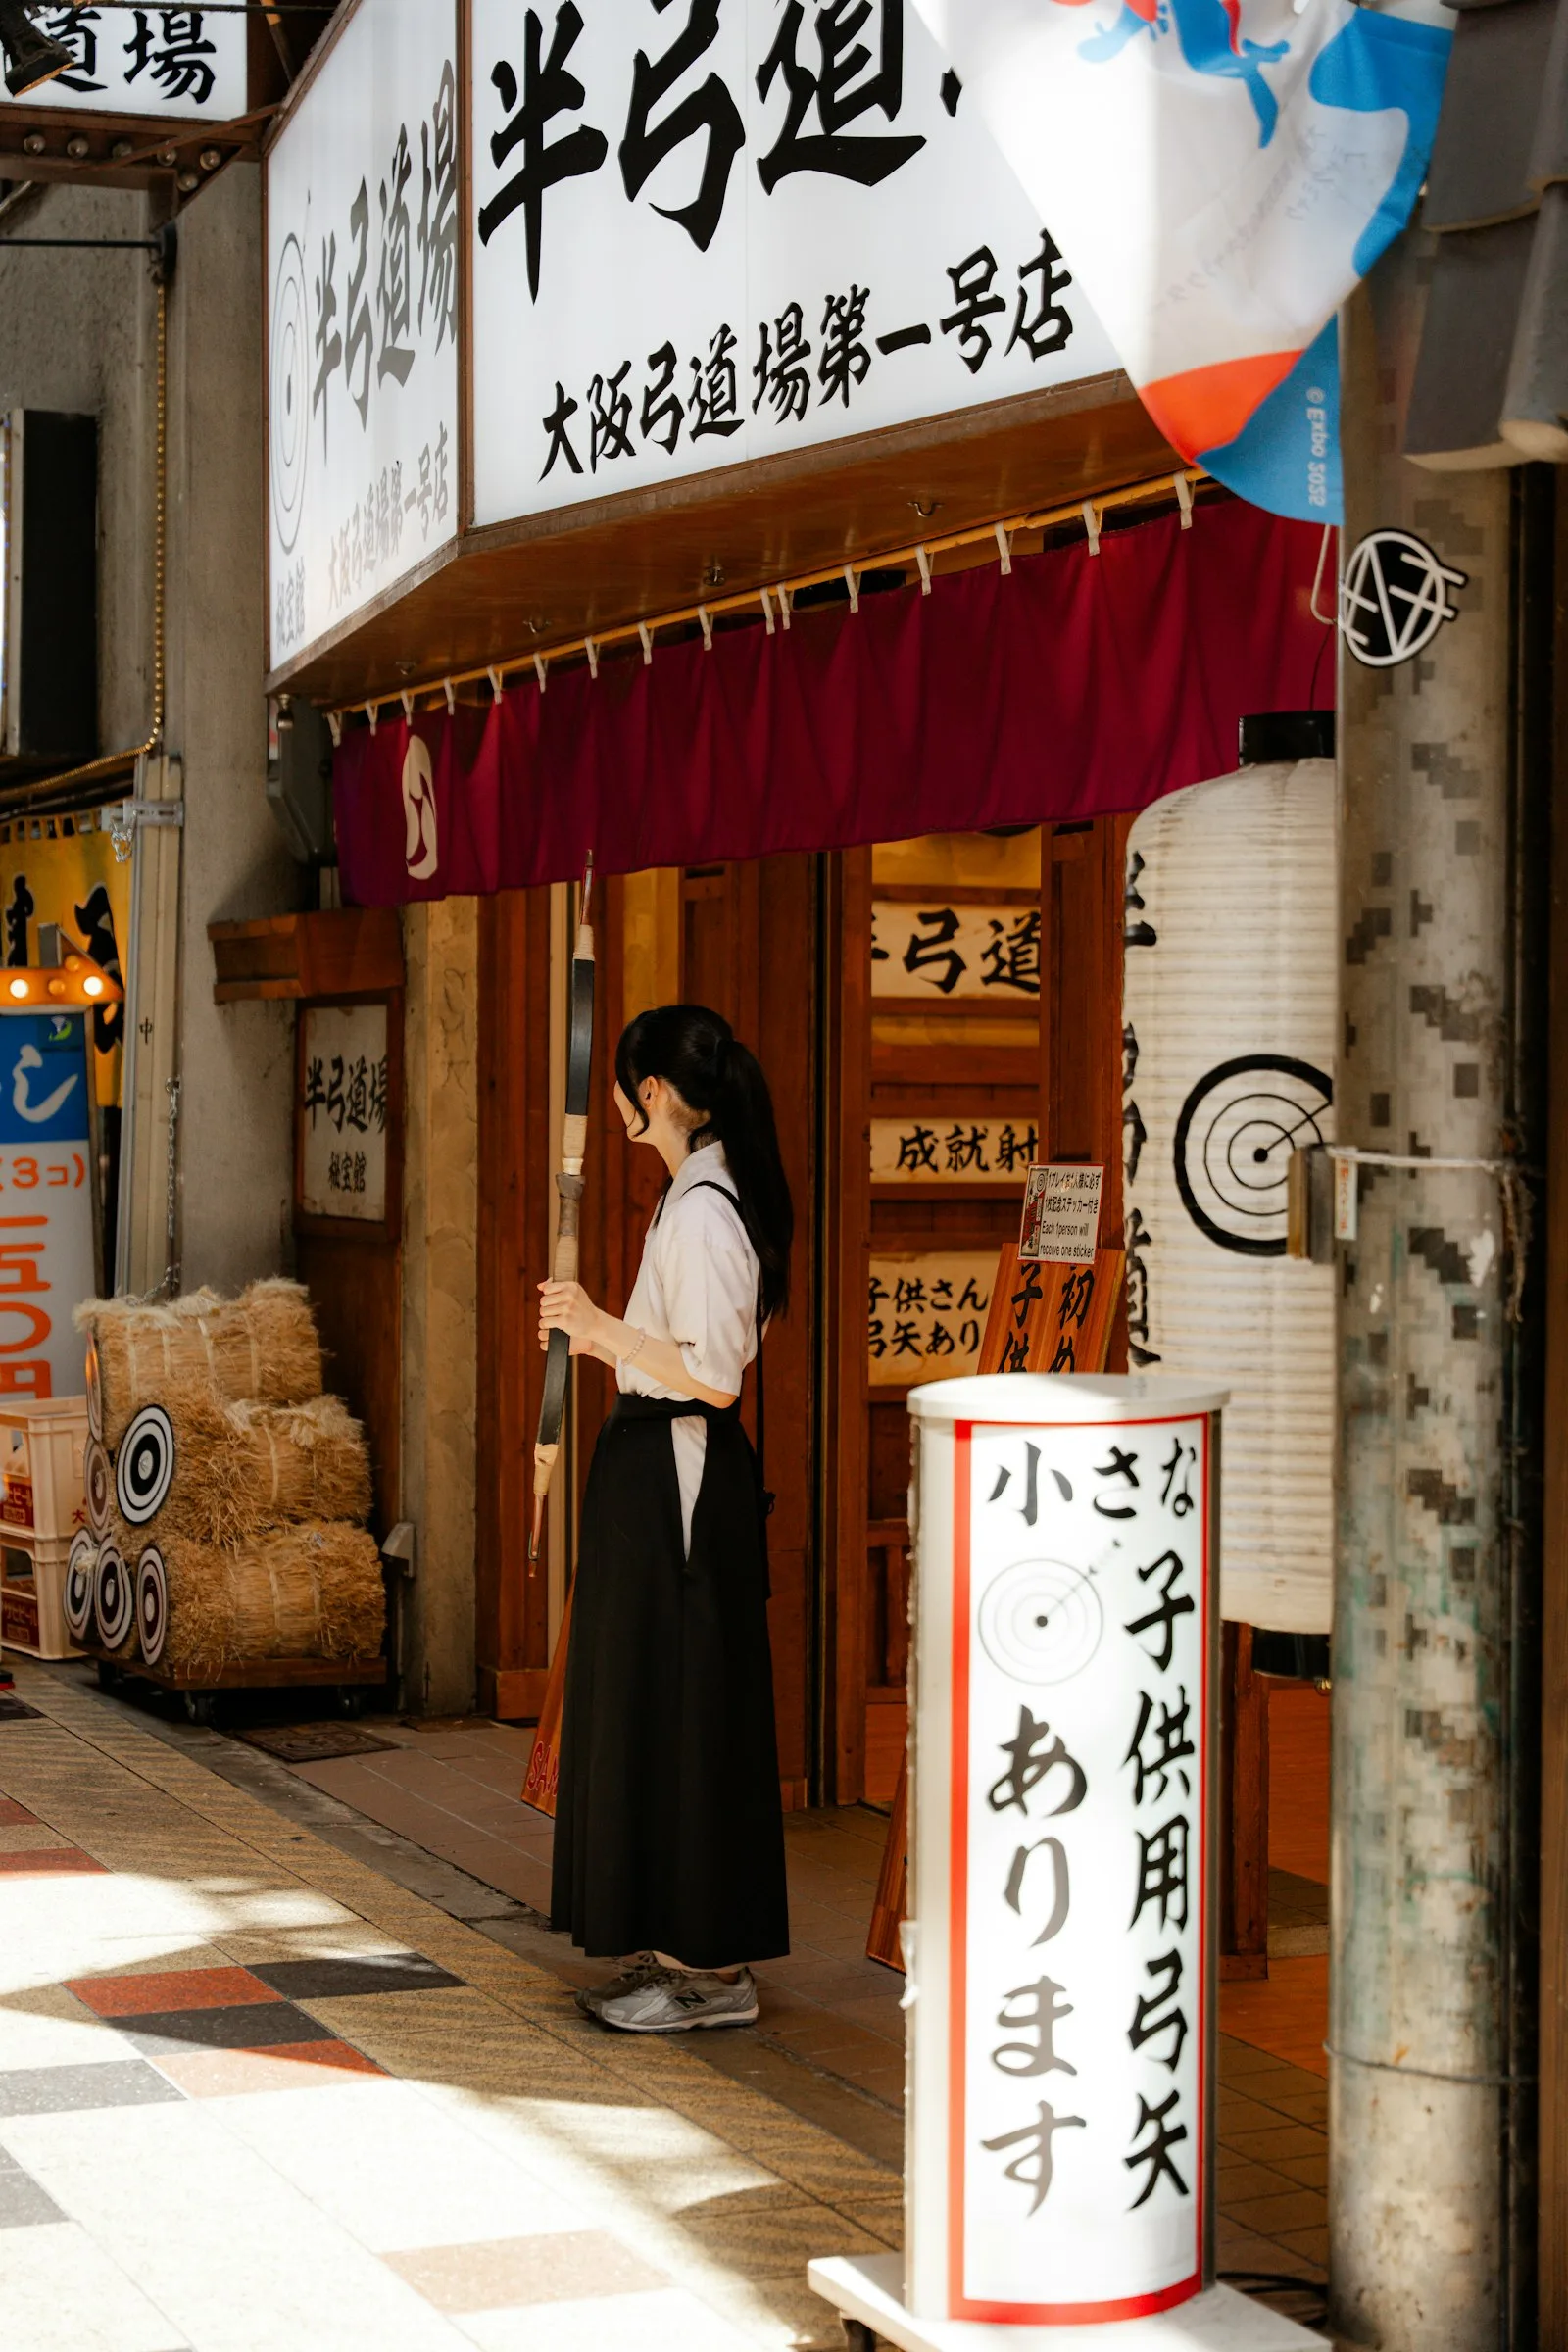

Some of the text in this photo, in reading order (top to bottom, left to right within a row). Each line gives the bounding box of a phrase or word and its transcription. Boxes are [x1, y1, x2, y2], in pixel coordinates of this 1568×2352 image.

[478, 0, 962, 305] 半弓道
[313, 59, 457, 467] 半弓道場
[539, 228, 1073, 483] 大阪弓道場第一号店
[139, 1017, 153, 1045] 中
[304, 1054, 389, 1134] 半弓道場
[0, 1153, 86, 1190] 3コ)
[869, 1124, 1039, 1173] 成就射
[1041, 1242, 1094, 1258] receive one sticker
[1042, 1220, 1054, 1235] Each
[1079, 1222, 1089, 1236] will
[869, 1277, 989, 1315] 子供さん
[869, 1319, 980, 1360] 弓矢あり
[988, 1436, 1197, 1528] 小さな
[1119, 1548, 1195, 2212] 子供用弓矢
[982, 1705, 1088, 2217] あります
